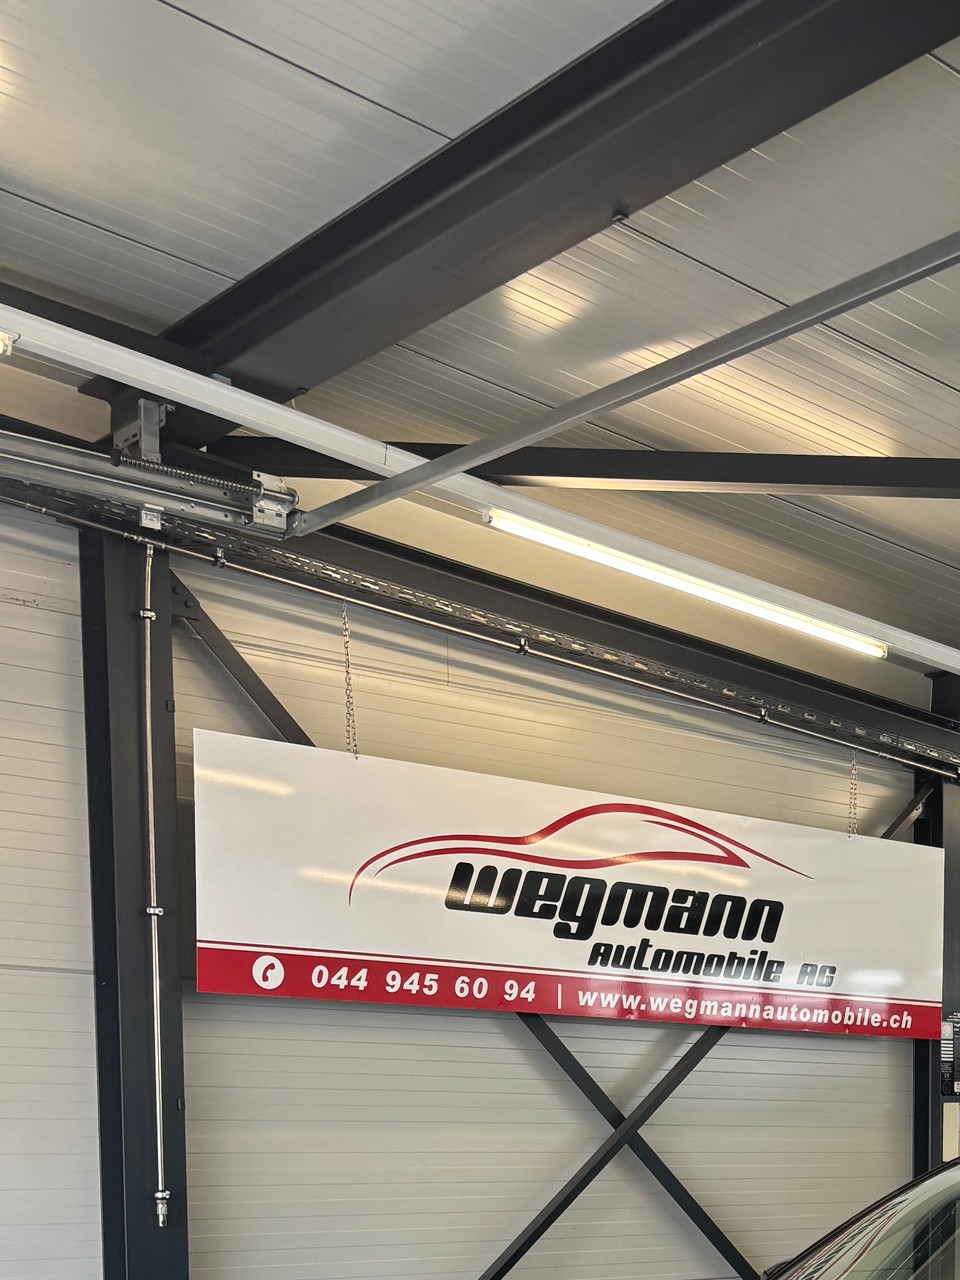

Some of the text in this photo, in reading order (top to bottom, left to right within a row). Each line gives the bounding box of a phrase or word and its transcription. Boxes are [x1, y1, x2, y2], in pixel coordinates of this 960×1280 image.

[444, 861, 785, 943] wegmann
[311, 965, 913, 1029] 044 945 60 94 www.wegmannautomobile.ch
[796, 962, 837, 988] AG
